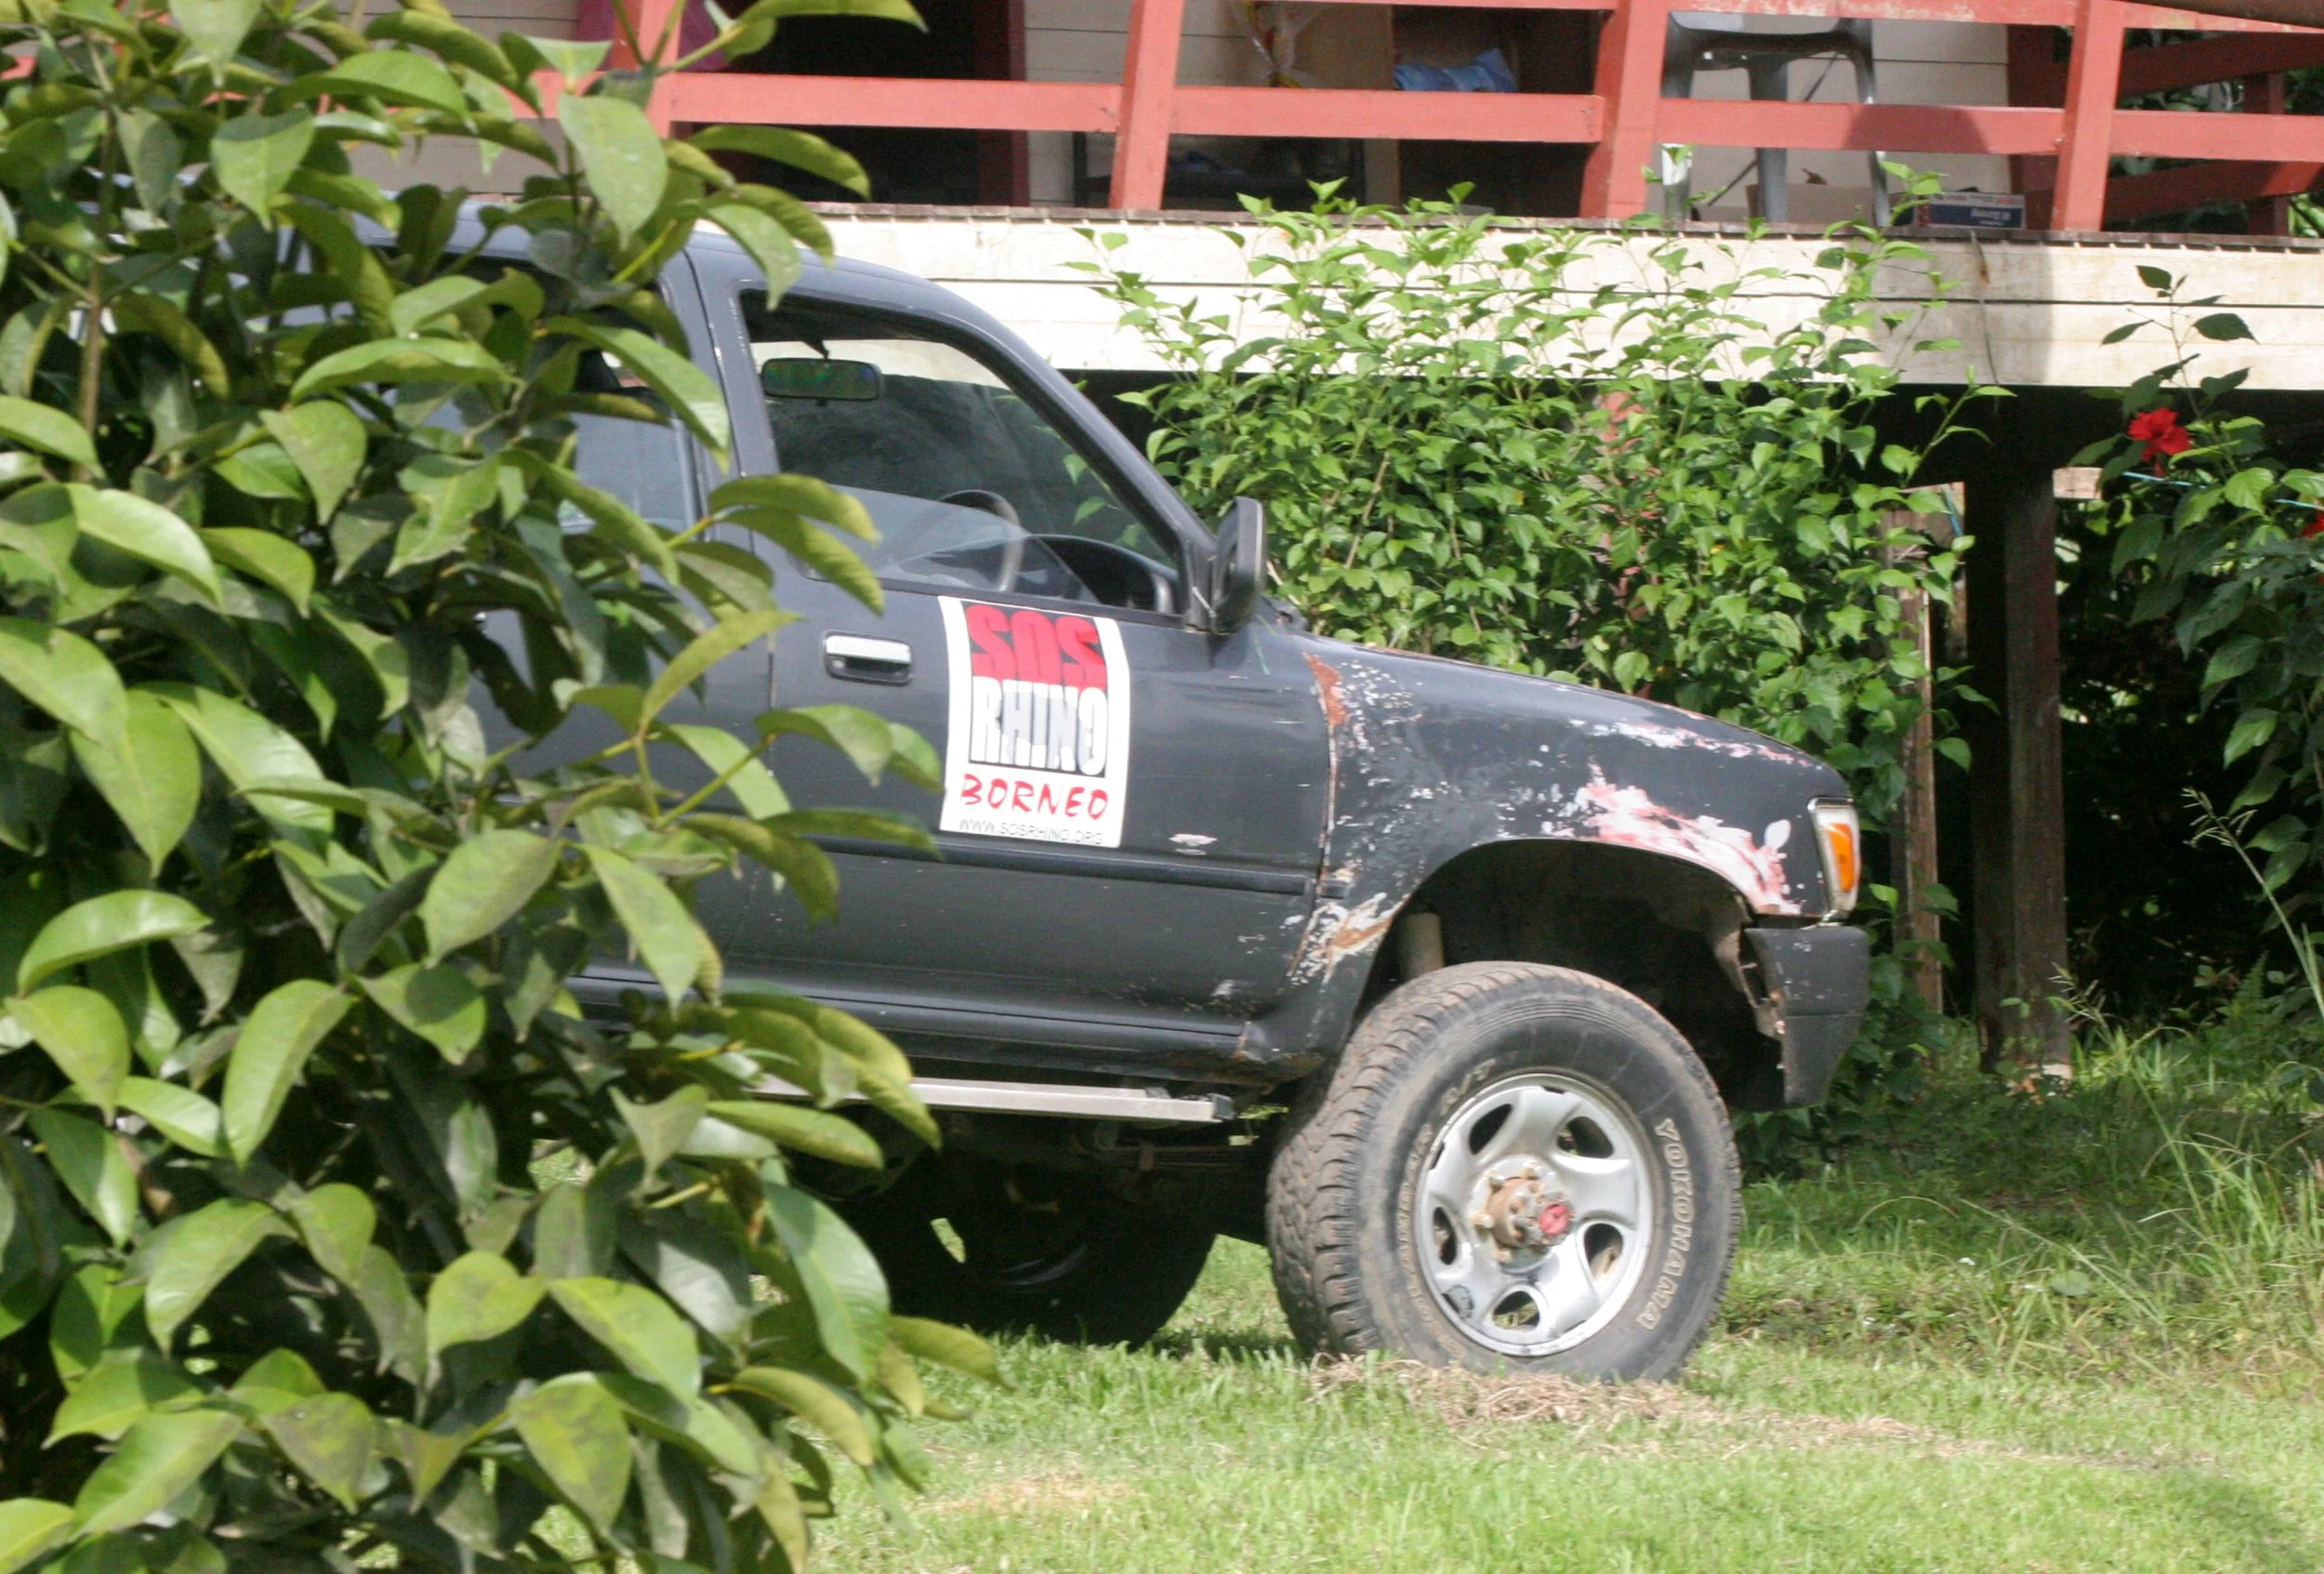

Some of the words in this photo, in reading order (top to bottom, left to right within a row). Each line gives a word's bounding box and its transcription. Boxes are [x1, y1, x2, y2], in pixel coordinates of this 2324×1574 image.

[966, 605, 1107, 690] SOS
[970, 676, 1108, 776] RHINO
[960, 774, 1108, 820] BORNEO
[1635, 1118, 1695, 1330] YOKOHAMA
